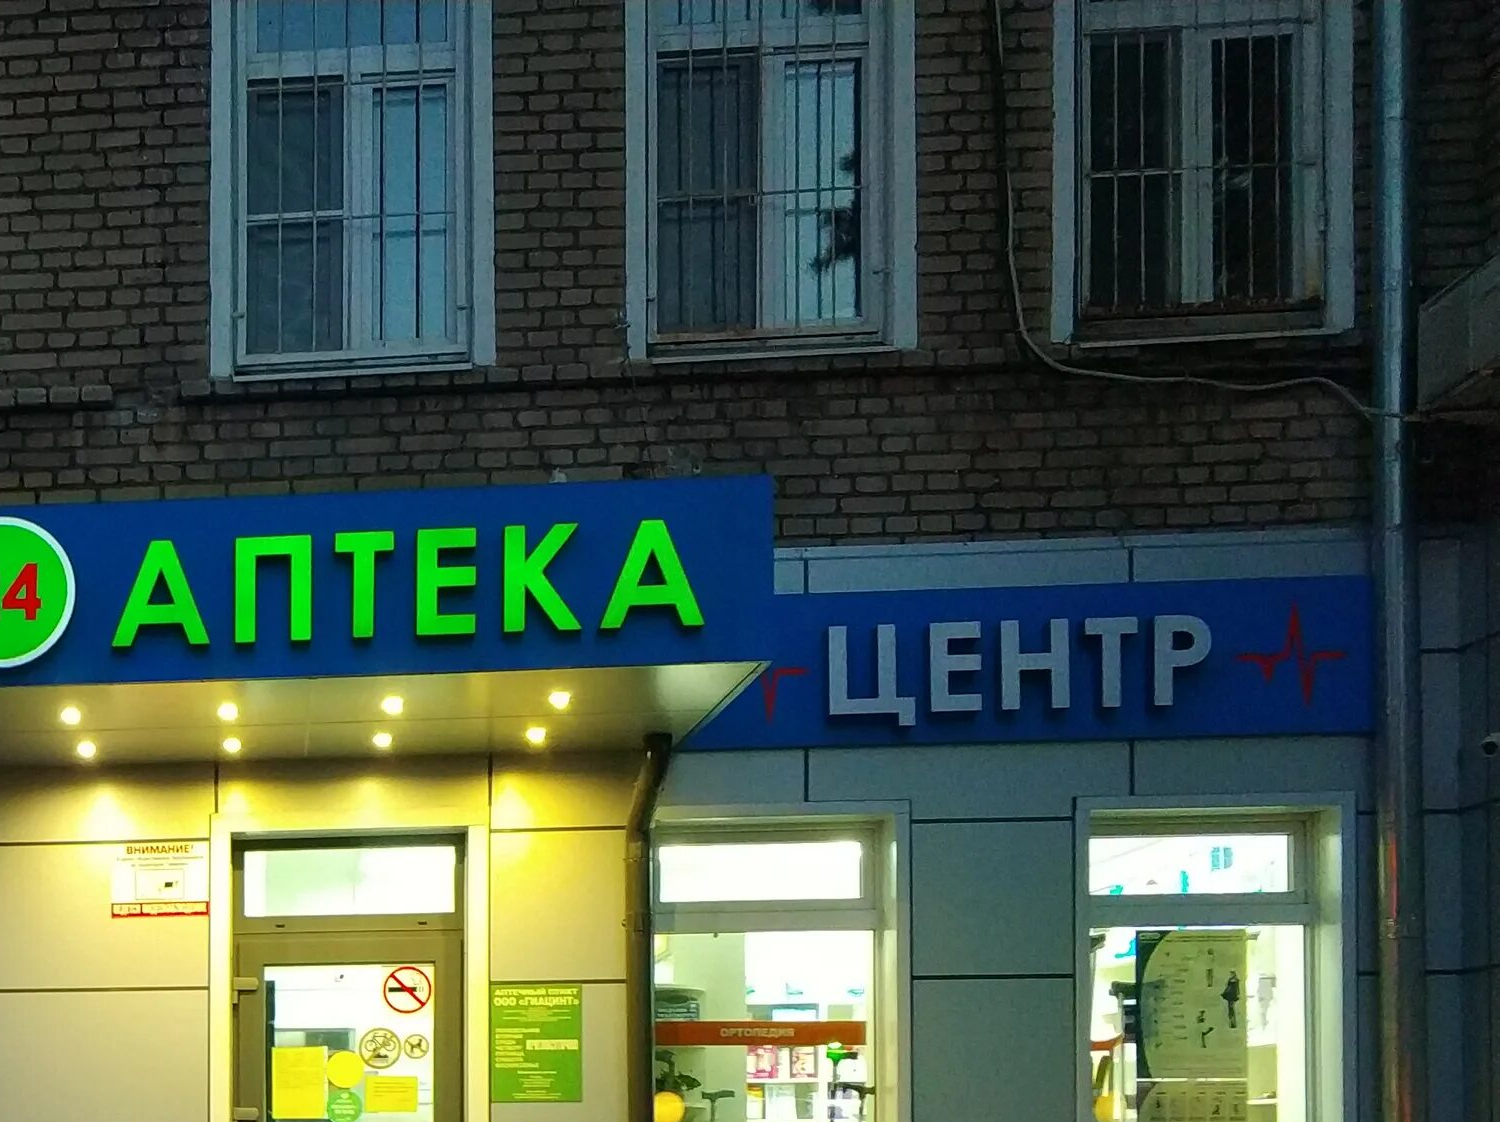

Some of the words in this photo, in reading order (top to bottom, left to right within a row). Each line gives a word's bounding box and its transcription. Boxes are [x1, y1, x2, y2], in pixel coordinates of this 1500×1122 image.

[111, 519, 705, 648] АПТЕКА
[828, 614, 1213, 726] ЦЕНТР
[493, 997, 517, 1007] ООО
[720, 1027, 795, 1039] ОРТОПЕДИЯ
